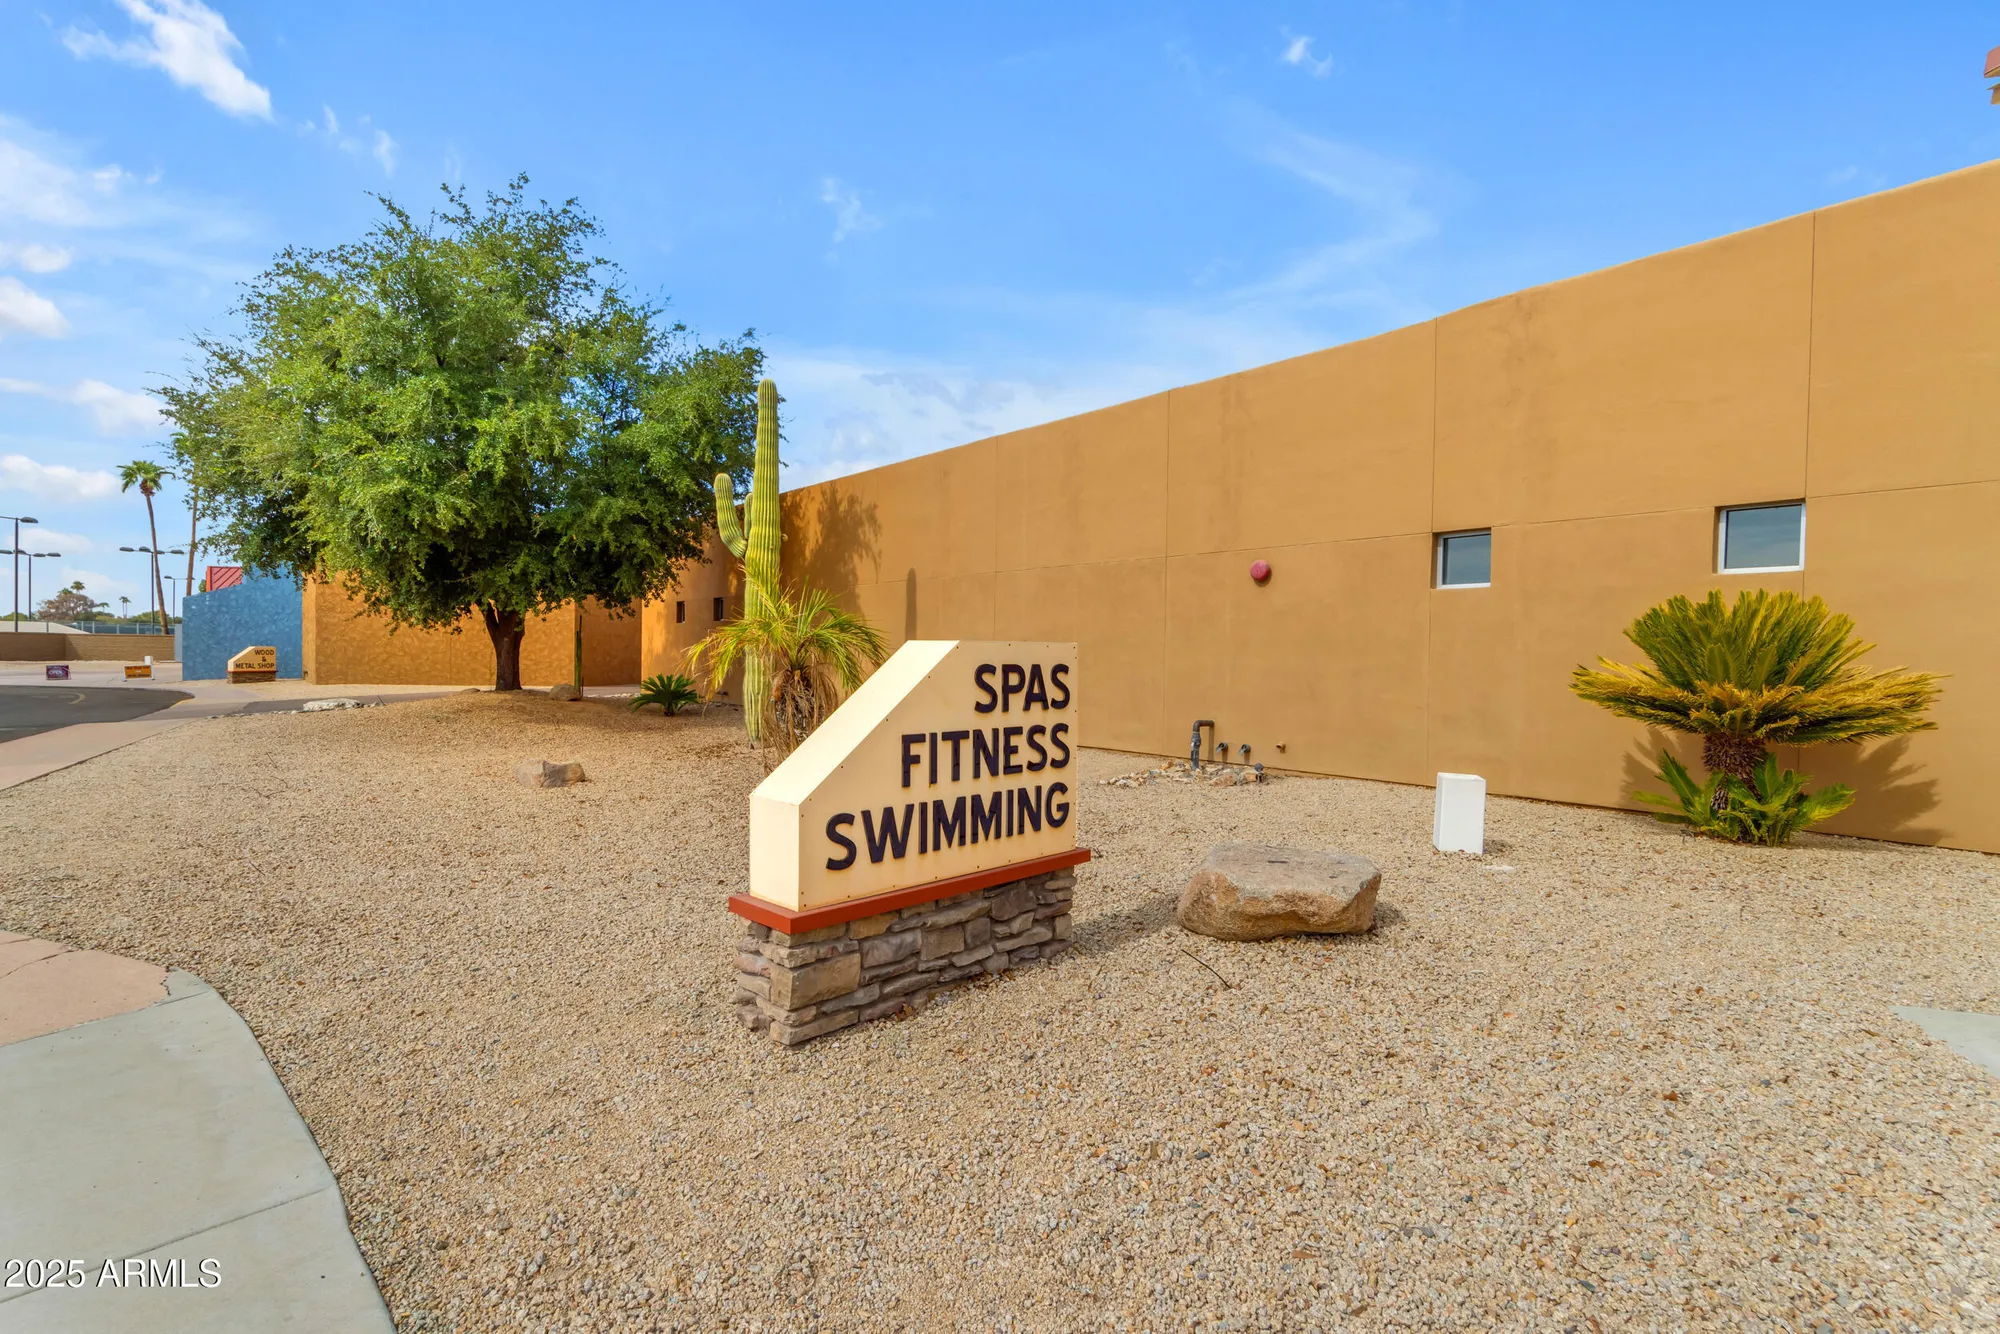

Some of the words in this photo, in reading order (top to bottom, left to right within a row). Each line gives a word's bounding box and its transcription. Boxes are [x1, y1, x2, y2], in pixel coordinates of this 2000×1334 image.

[974, 663, 1071, 714] SPAS
[901, 722, 1071, 788] FITNESS
[825, 781, 1070, 871] SWIMMING
